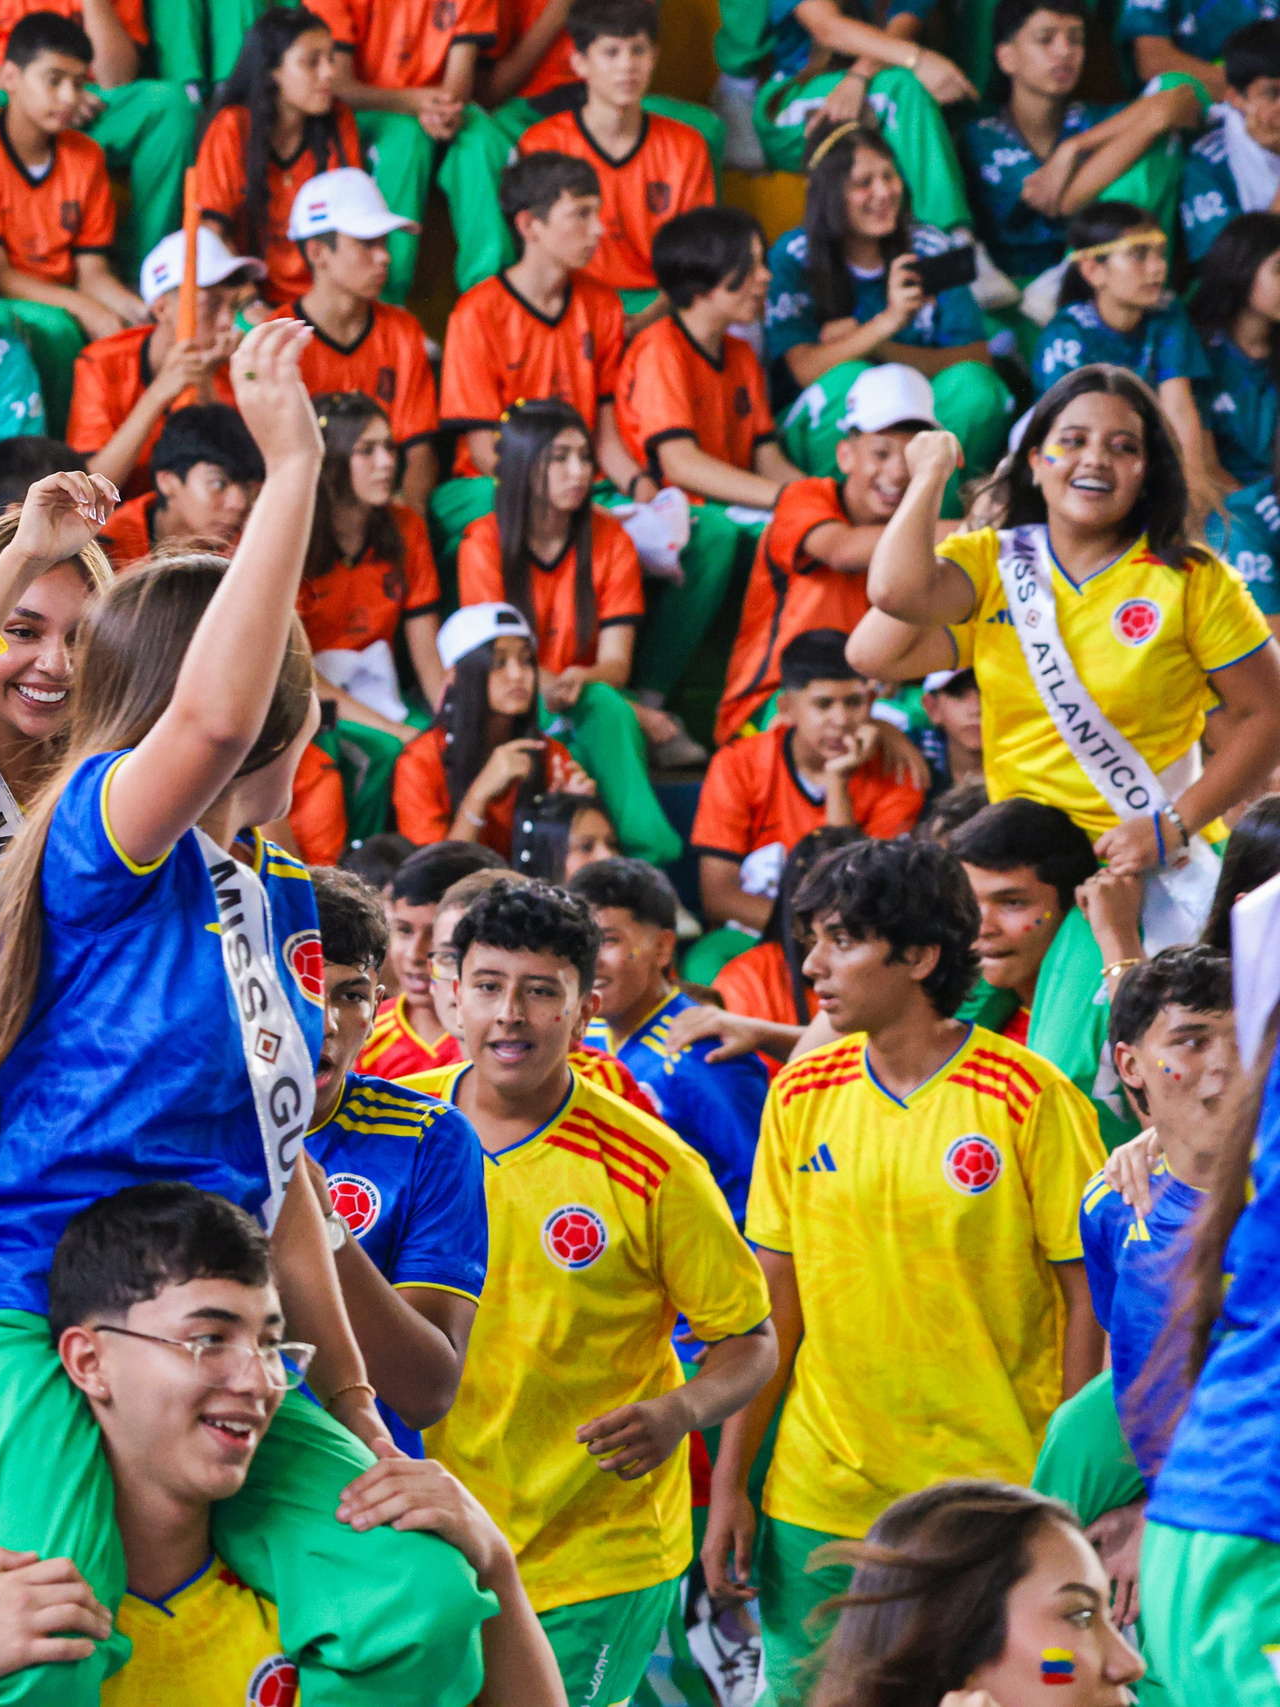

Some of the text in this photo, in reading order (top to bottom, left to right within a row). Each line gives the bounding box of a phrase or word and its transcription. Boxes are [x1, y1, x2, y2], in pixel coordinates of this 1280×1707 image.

[1032, 641, 1150, 810] ATLANTICO
[209, 860, 304, 1191] MISS GU
